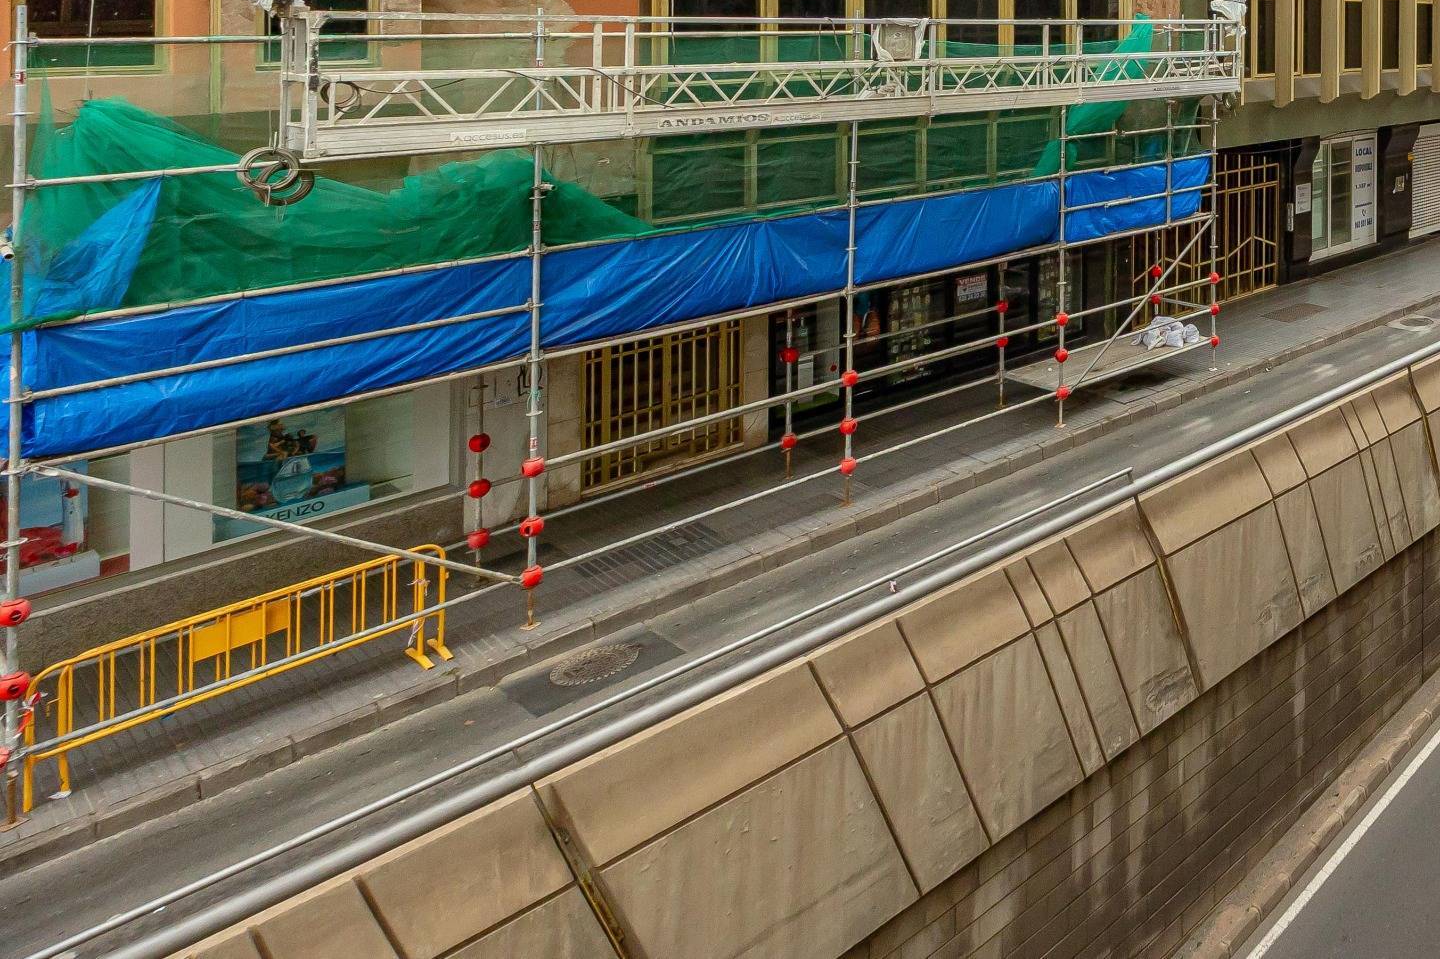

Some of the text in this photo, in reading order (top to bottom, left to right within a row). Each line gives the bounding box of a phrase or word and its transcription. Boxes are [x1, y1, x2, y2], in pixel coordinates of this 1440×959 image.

[659, 113, 771, 128] ANDAMIOS
[1355, 147, 1373, 157] LOCAL
[265, 501, 325, 521] KENZO
